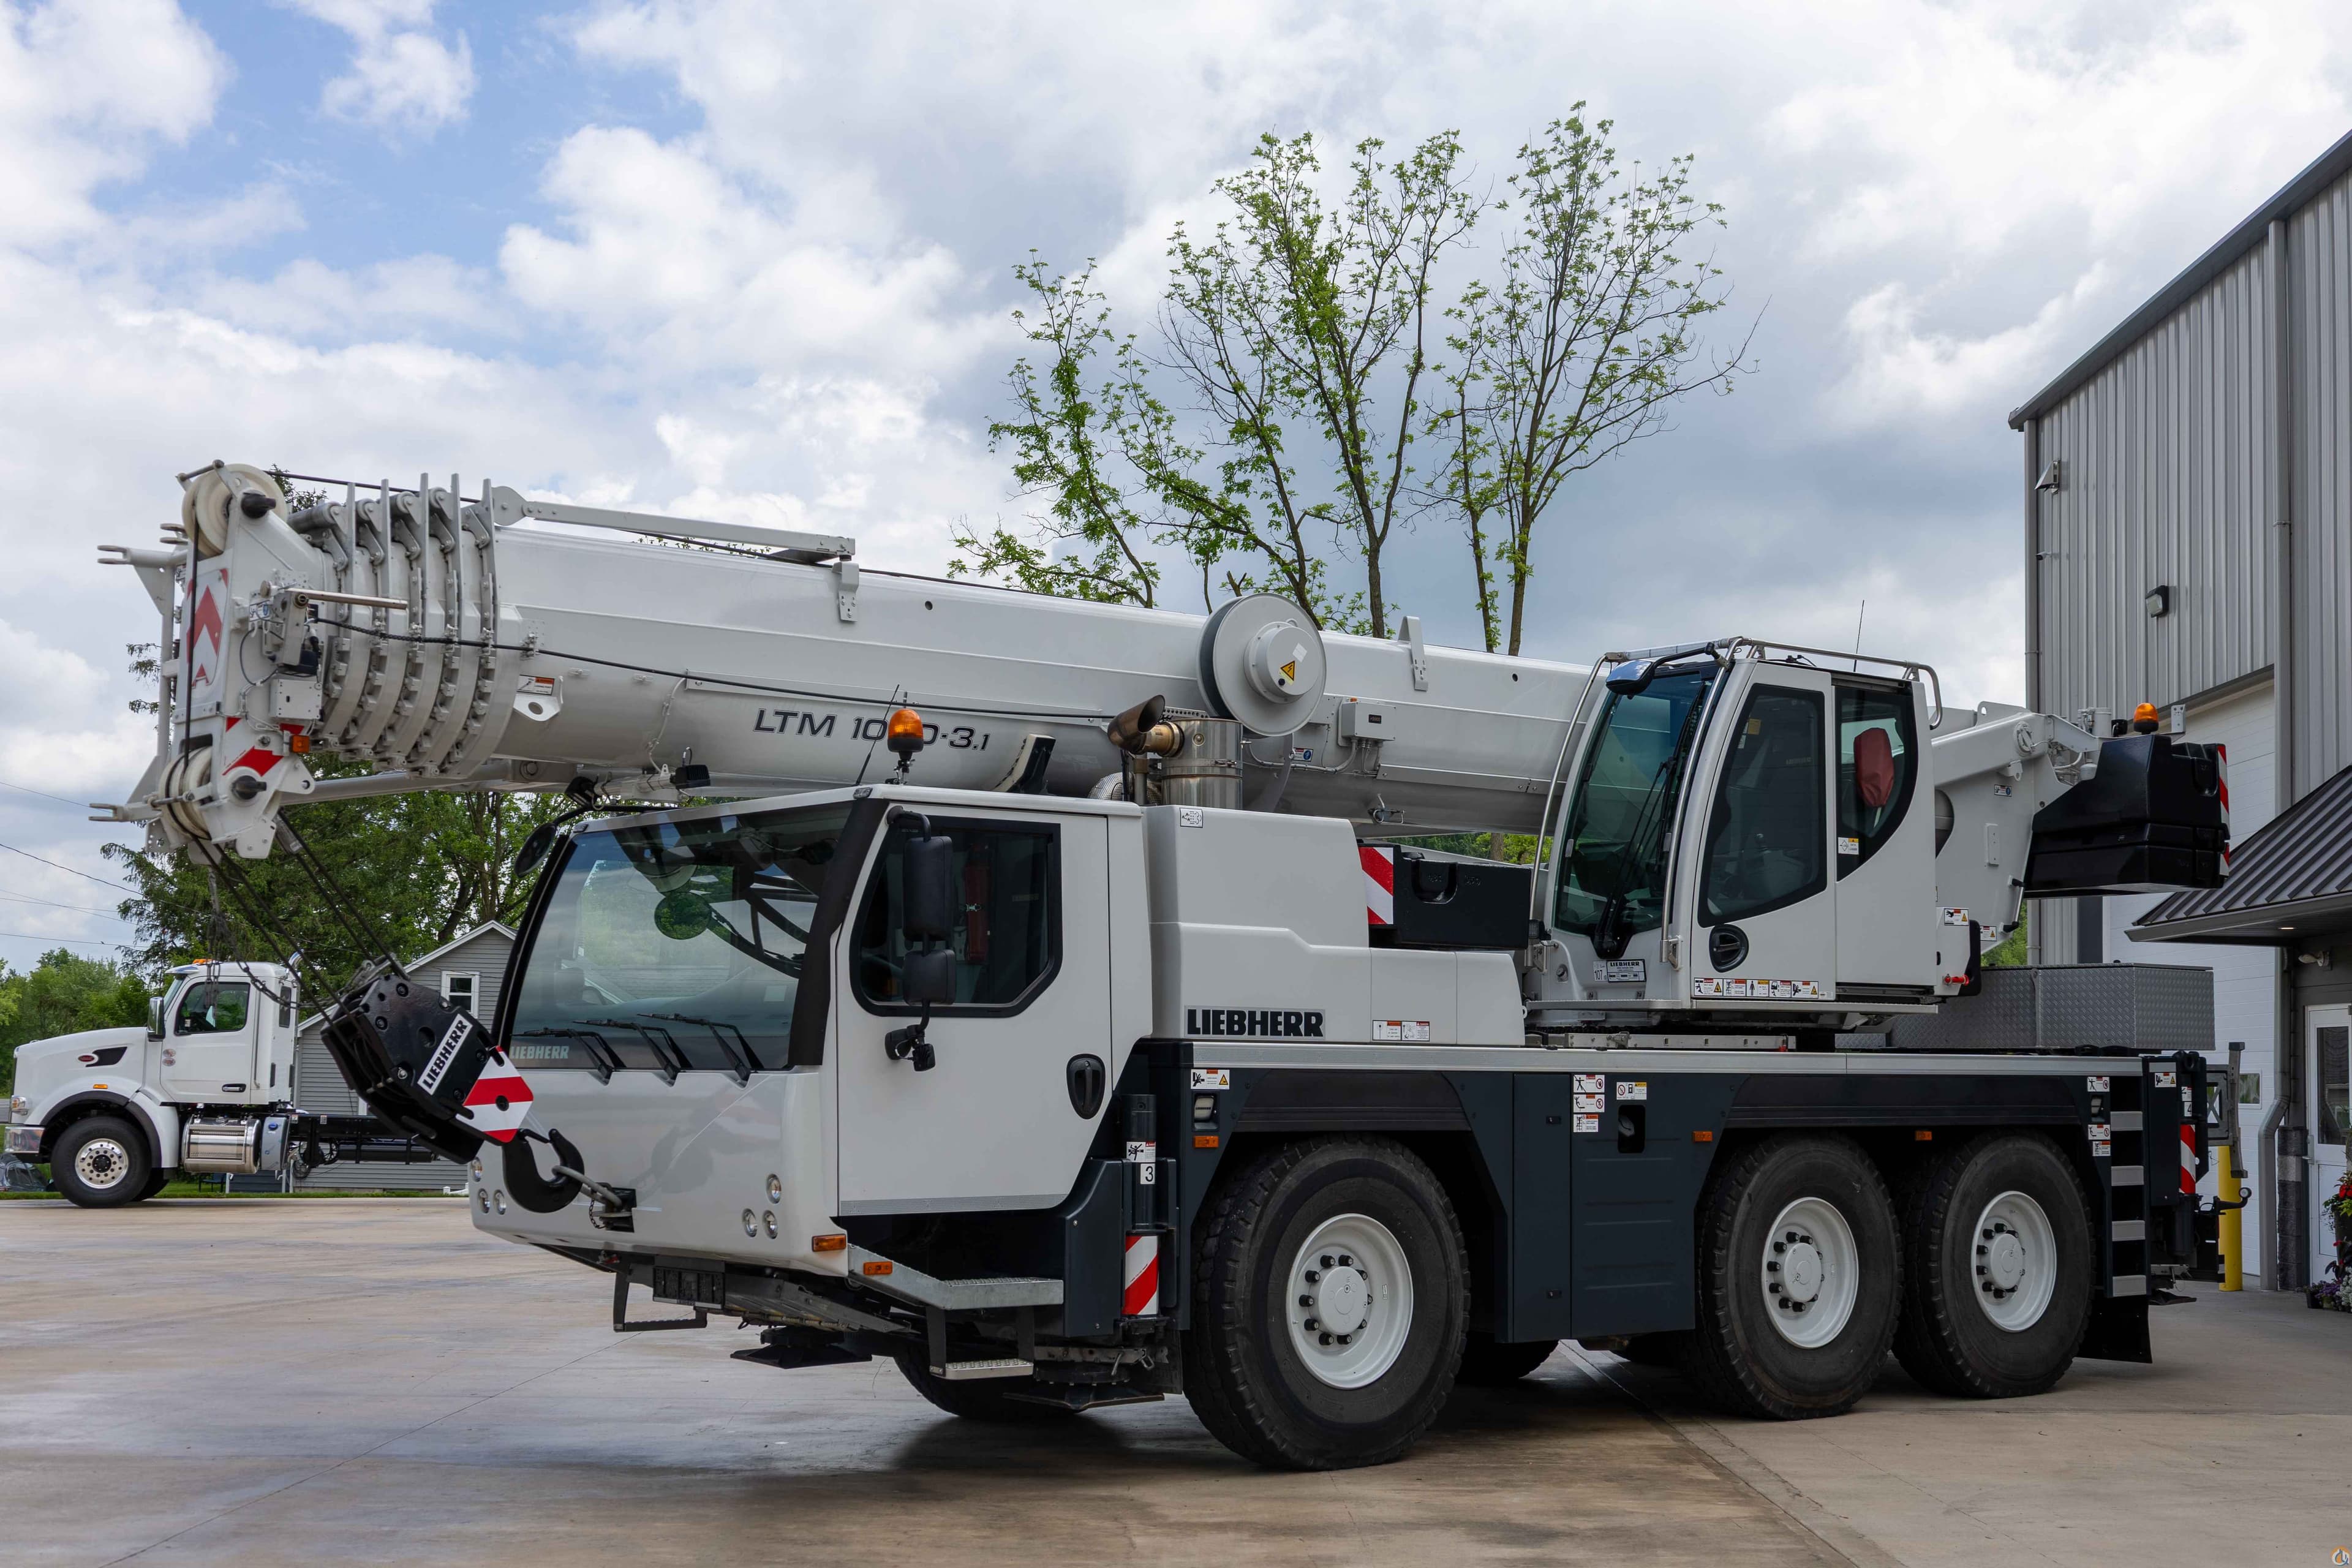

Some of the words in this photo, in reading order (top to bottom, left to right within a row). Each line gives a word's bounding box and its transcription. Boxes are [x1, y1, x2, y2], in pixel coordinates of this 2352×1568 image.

[753, 708, 838, 737] LTM
[851, 716, 991, 751] 100-3.1
[1594, 970, 1603, 981] 107
[1187, 1009, 1324, 1037] LIEBHERR
[422, 1020, 468, 1090] LIEBHERR
[510, 1046, 569, 1059] LIEBHERR
[1145, 1166, 1153, 1182] 3
